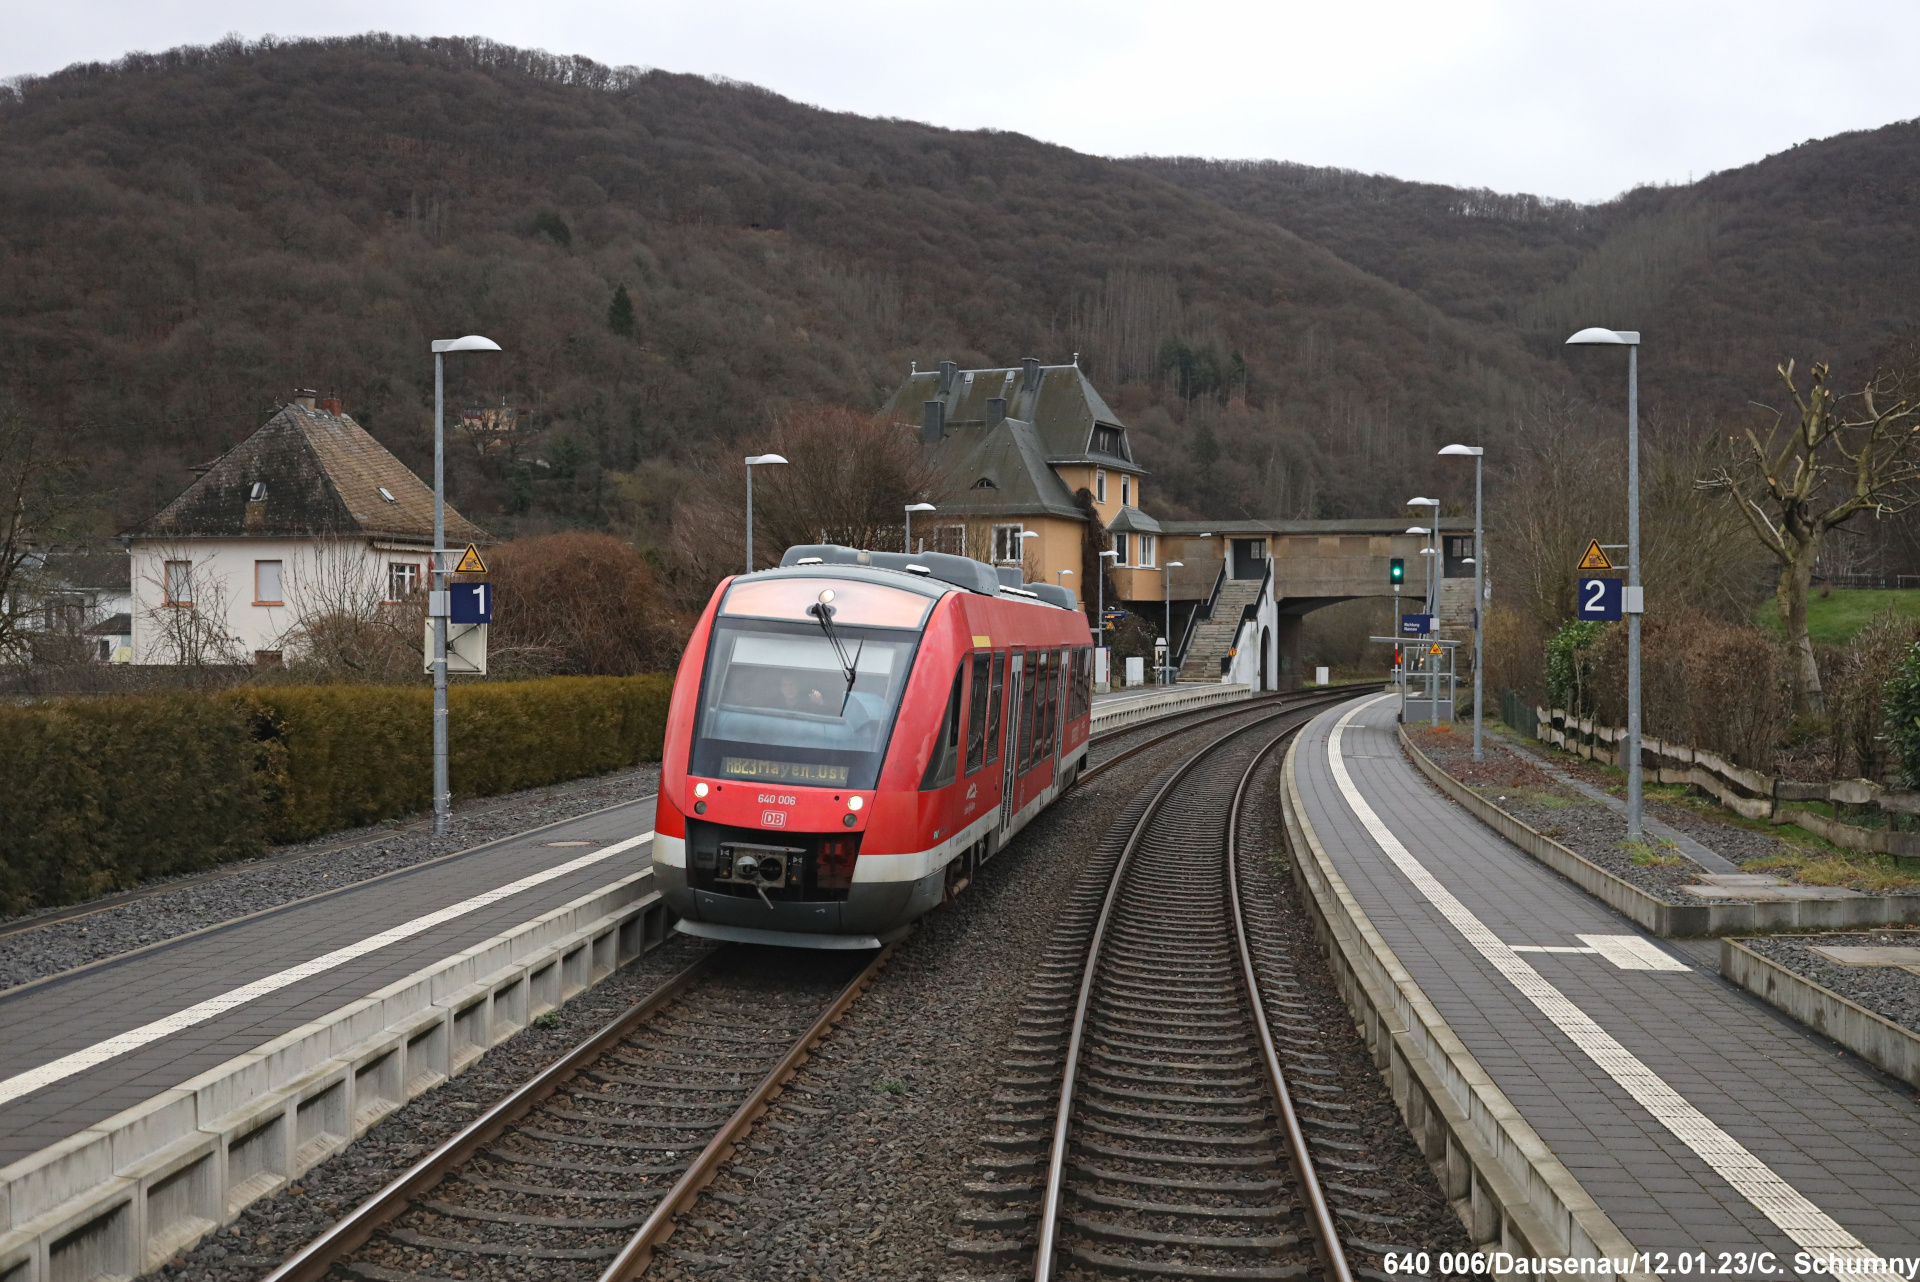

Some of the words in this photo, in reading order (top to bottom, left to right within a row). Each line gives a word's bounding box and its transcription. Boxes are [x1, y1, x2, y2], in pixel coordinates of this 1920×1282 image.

[472, 584, 486, 615] 1
[1584, 579, 1606, 612] 2
[757, 793, 776, 804] 640
[777, 794, 797, 806] 006
[764, 812, 784, 825] DB
